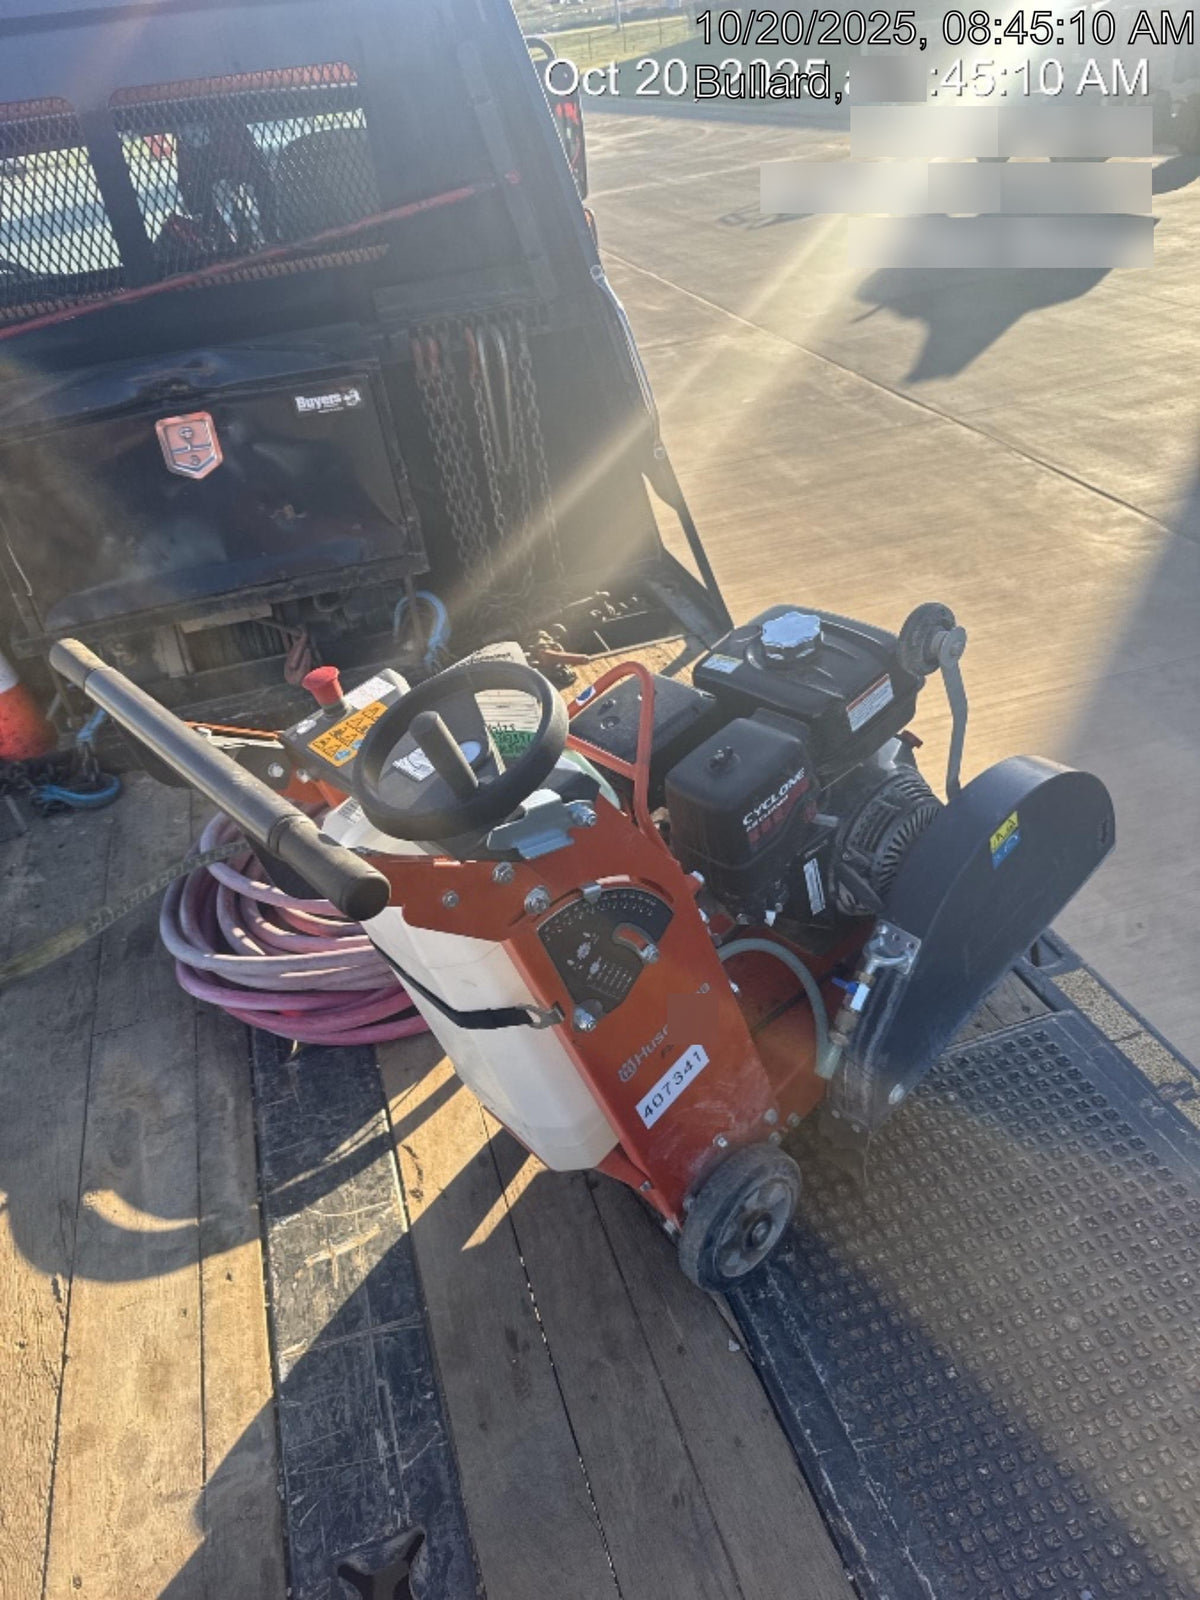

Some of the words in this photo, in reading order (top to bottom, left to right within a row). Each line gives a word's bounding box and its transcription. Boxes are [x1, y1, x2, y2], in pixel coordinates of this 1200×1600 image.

[295, 393, 342, 411] Buyers
[742, 767, 805, 826] CYCLONE
[643, 1050, 702, 1118] 407341
